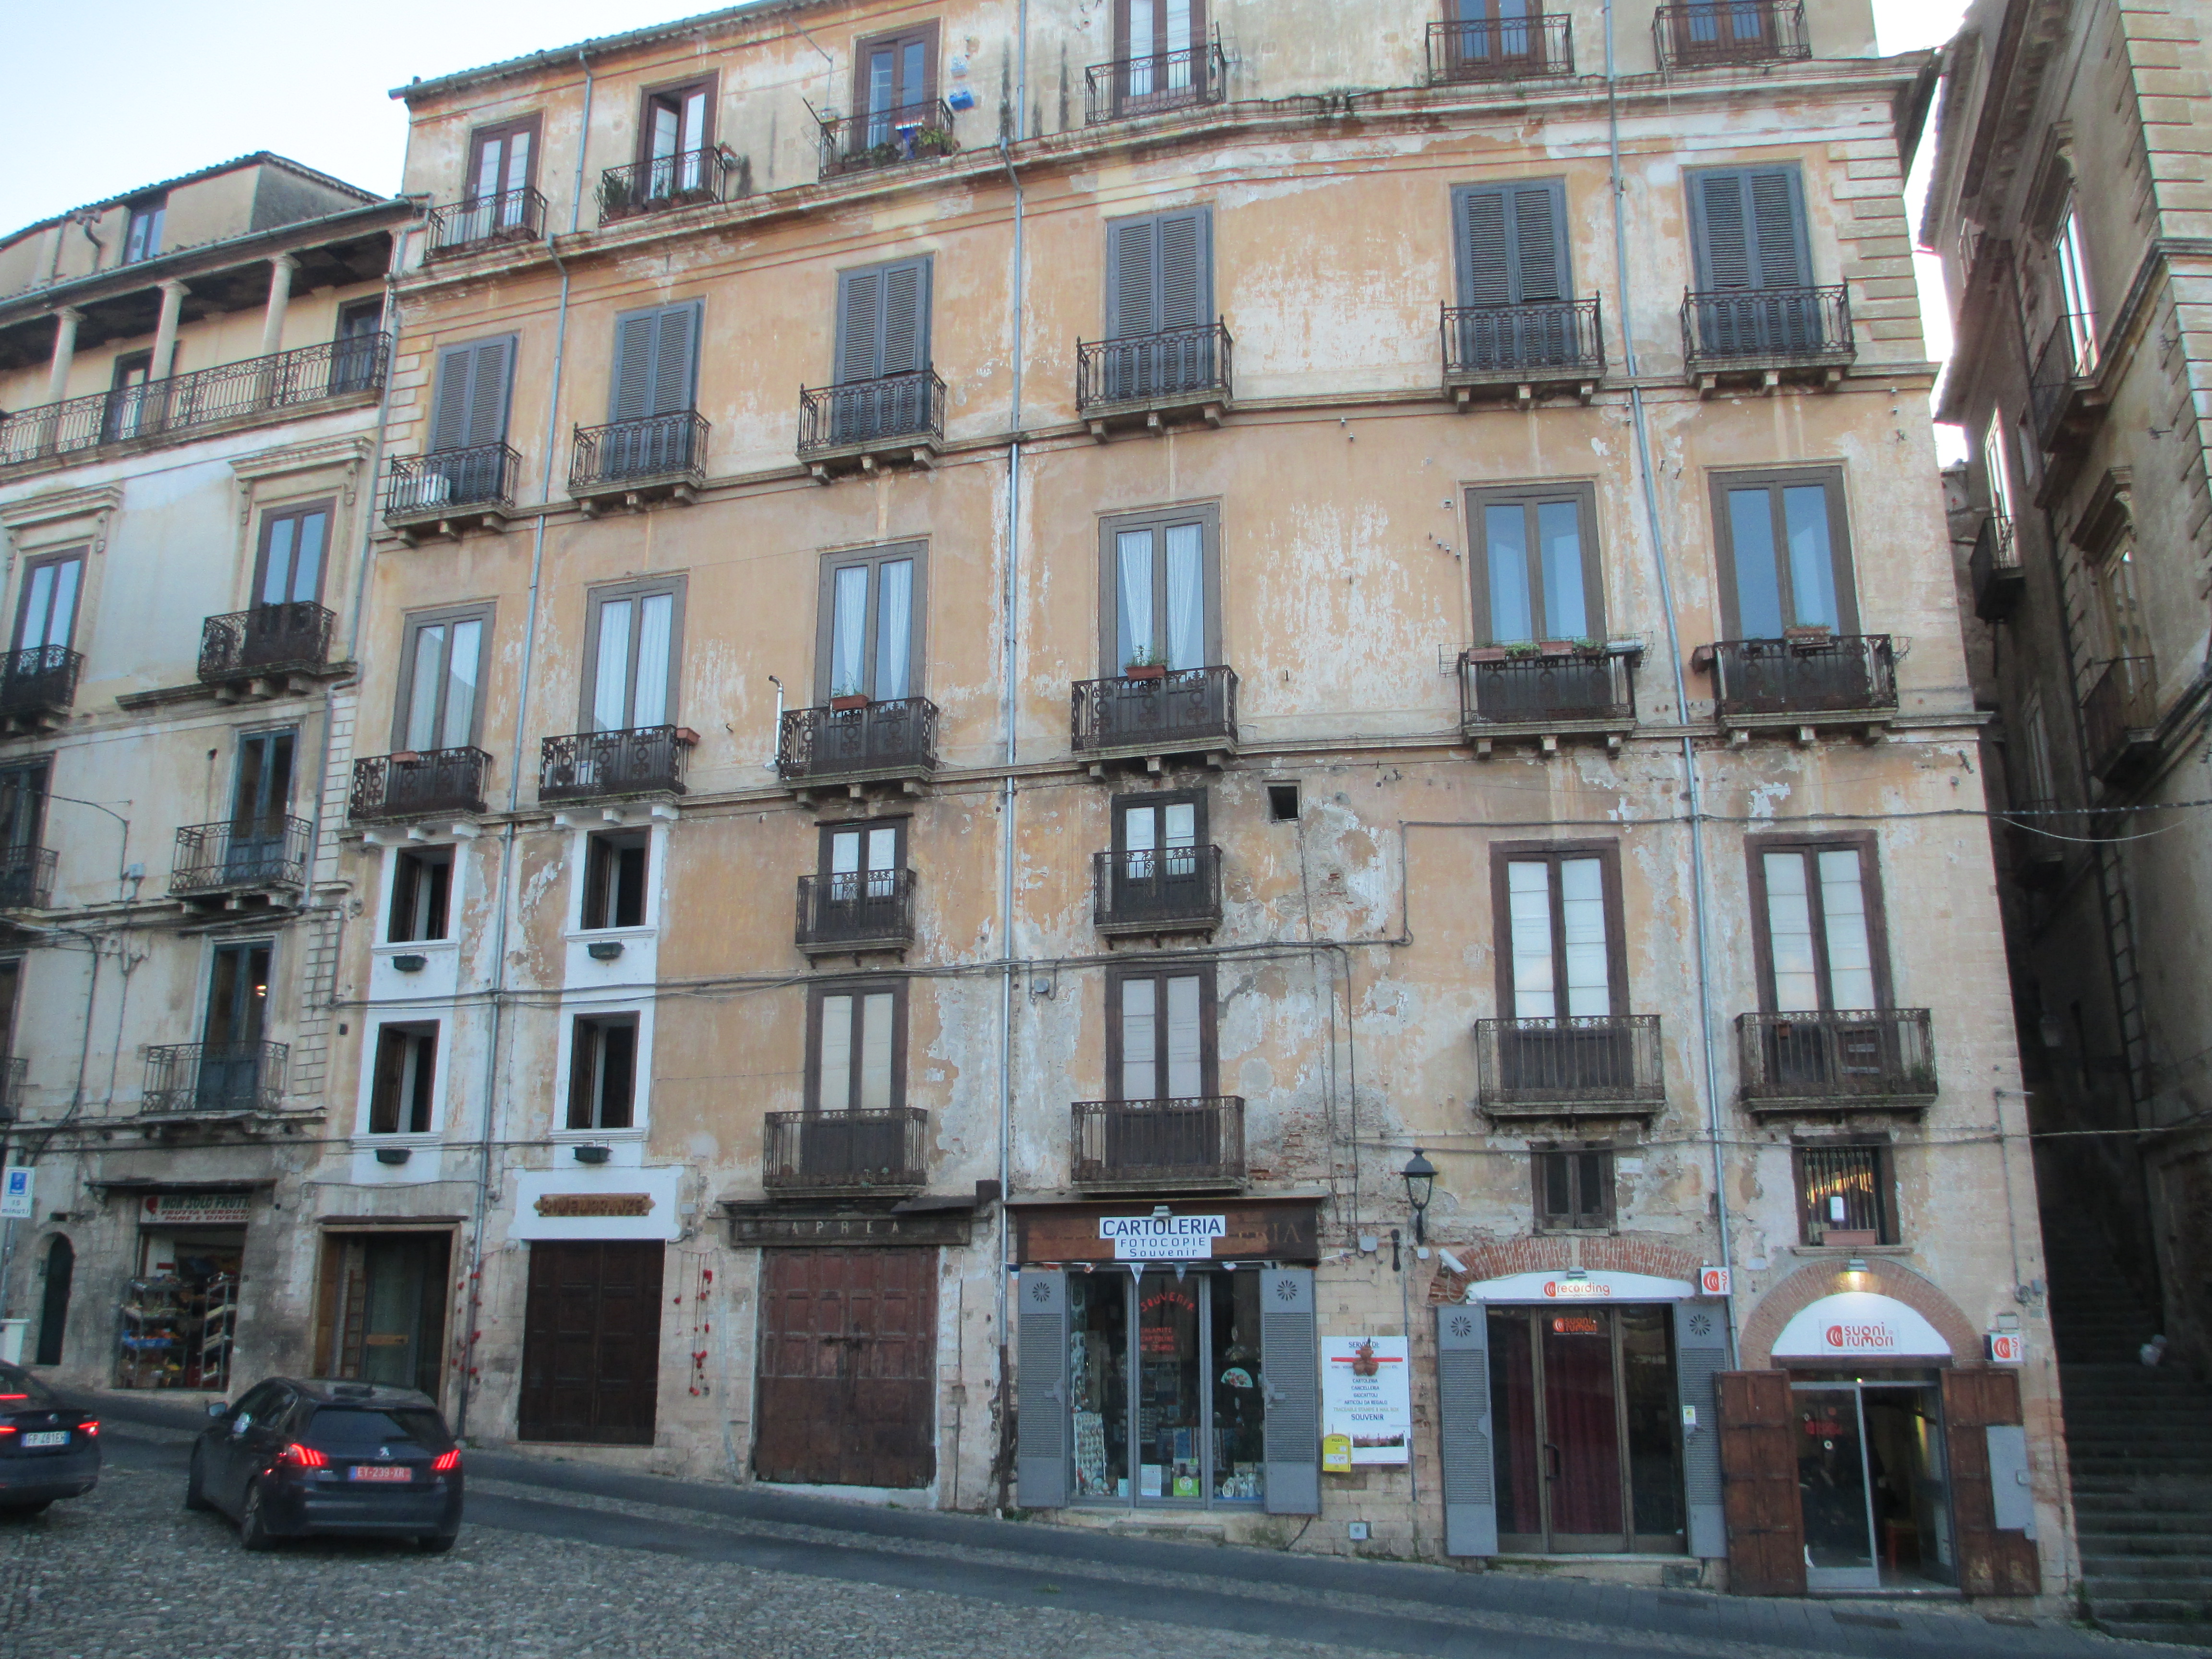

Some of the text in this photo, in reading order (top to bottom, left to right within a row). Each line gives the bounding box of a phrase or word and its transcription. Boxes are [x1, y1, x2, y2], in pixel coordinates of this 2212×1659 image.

[792, 1221, 900, 1235] APREA
[1103, 1218, 1222, 1236] CARTOLERIA
[1120, 1237, 1206, 1248] FOTOCOPIE
[1130, 1248, 1198, 1257] Souvenir
[1557, 1282, 1611, 1296] recording
[1844, 1321, 1886, 1336] suoni
[1847, 1336, 1894, 1347] rumori
